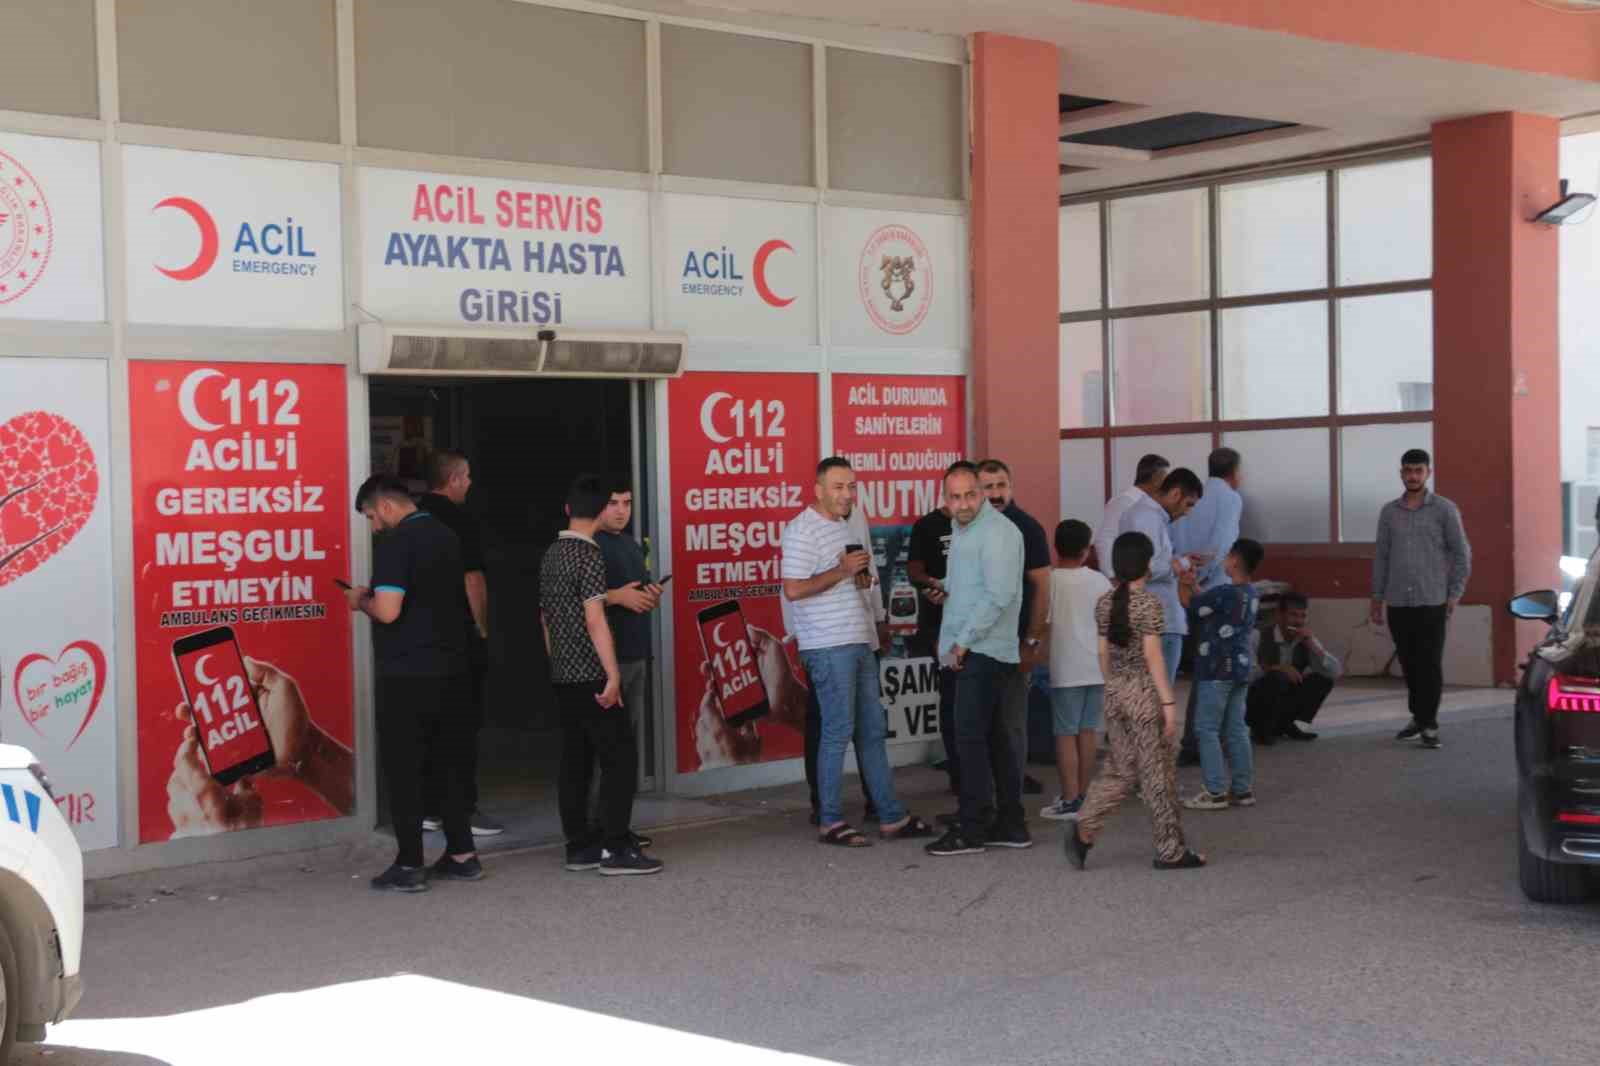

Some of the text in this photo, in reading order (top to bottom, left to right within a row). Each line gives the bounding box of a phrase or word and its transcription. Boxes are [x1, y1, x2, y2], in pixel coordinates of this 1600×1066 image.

[233, 216, 317, 256] ACİL
[232, 259, 318, 277] EMERGENCY
[384, 232, 626, 277] AYAKTA HASTA
[682, 245, 744, 280] ACİL
[681, 283, 745, 297] EMERGENCY
[221, 378, 301, 425] 112
[882, 386, 948, 406] DURUMDA
[729, 399, 785, 438] 112
[837, 449, 887, 471] NEMLİ
[155, 480, 326, 516] GEREKSİZ
[685, 482, 803, 511] GEREKSİZ
[155, 528, 326, 572] MEŞGUL
[685, 520, 785, 556] MEŞGU
[696, 555, 785, 585] ETMEYİ
[172, 571, 314, 607] ETMEYİN
[160, 608, 239, 627] AMBULANS
[713, 640, 751, 678] 112
[54, 680, 92, 708] hayat
[194, 675, 249, 723] 112
[207, 711, 259, 751] ACİL
